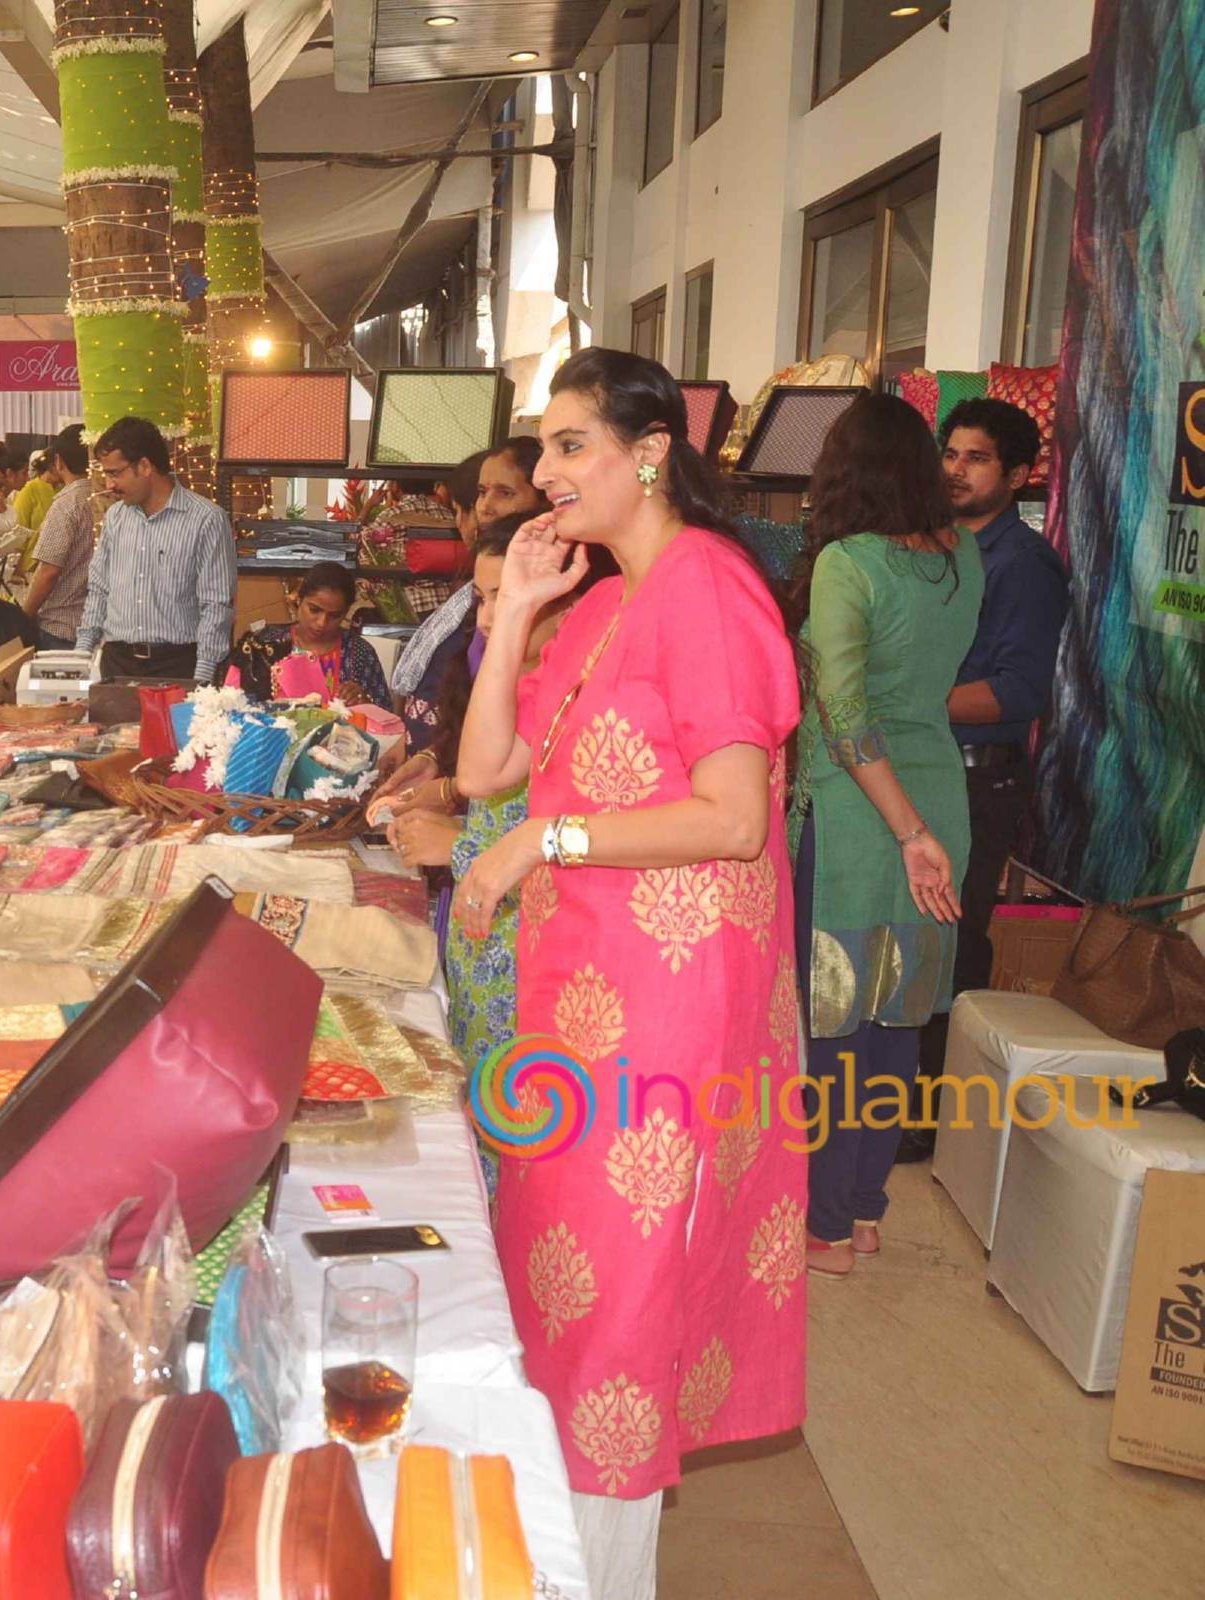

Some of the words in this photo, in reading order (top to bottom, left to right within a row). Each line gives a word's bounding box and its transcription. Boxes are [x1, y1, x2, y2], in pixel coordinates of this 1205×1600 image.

[1164, 509, 1199, 575] The
[1155, 1340, 1186, 1368] The
[1152, 1385, 1164, 1396] AN
